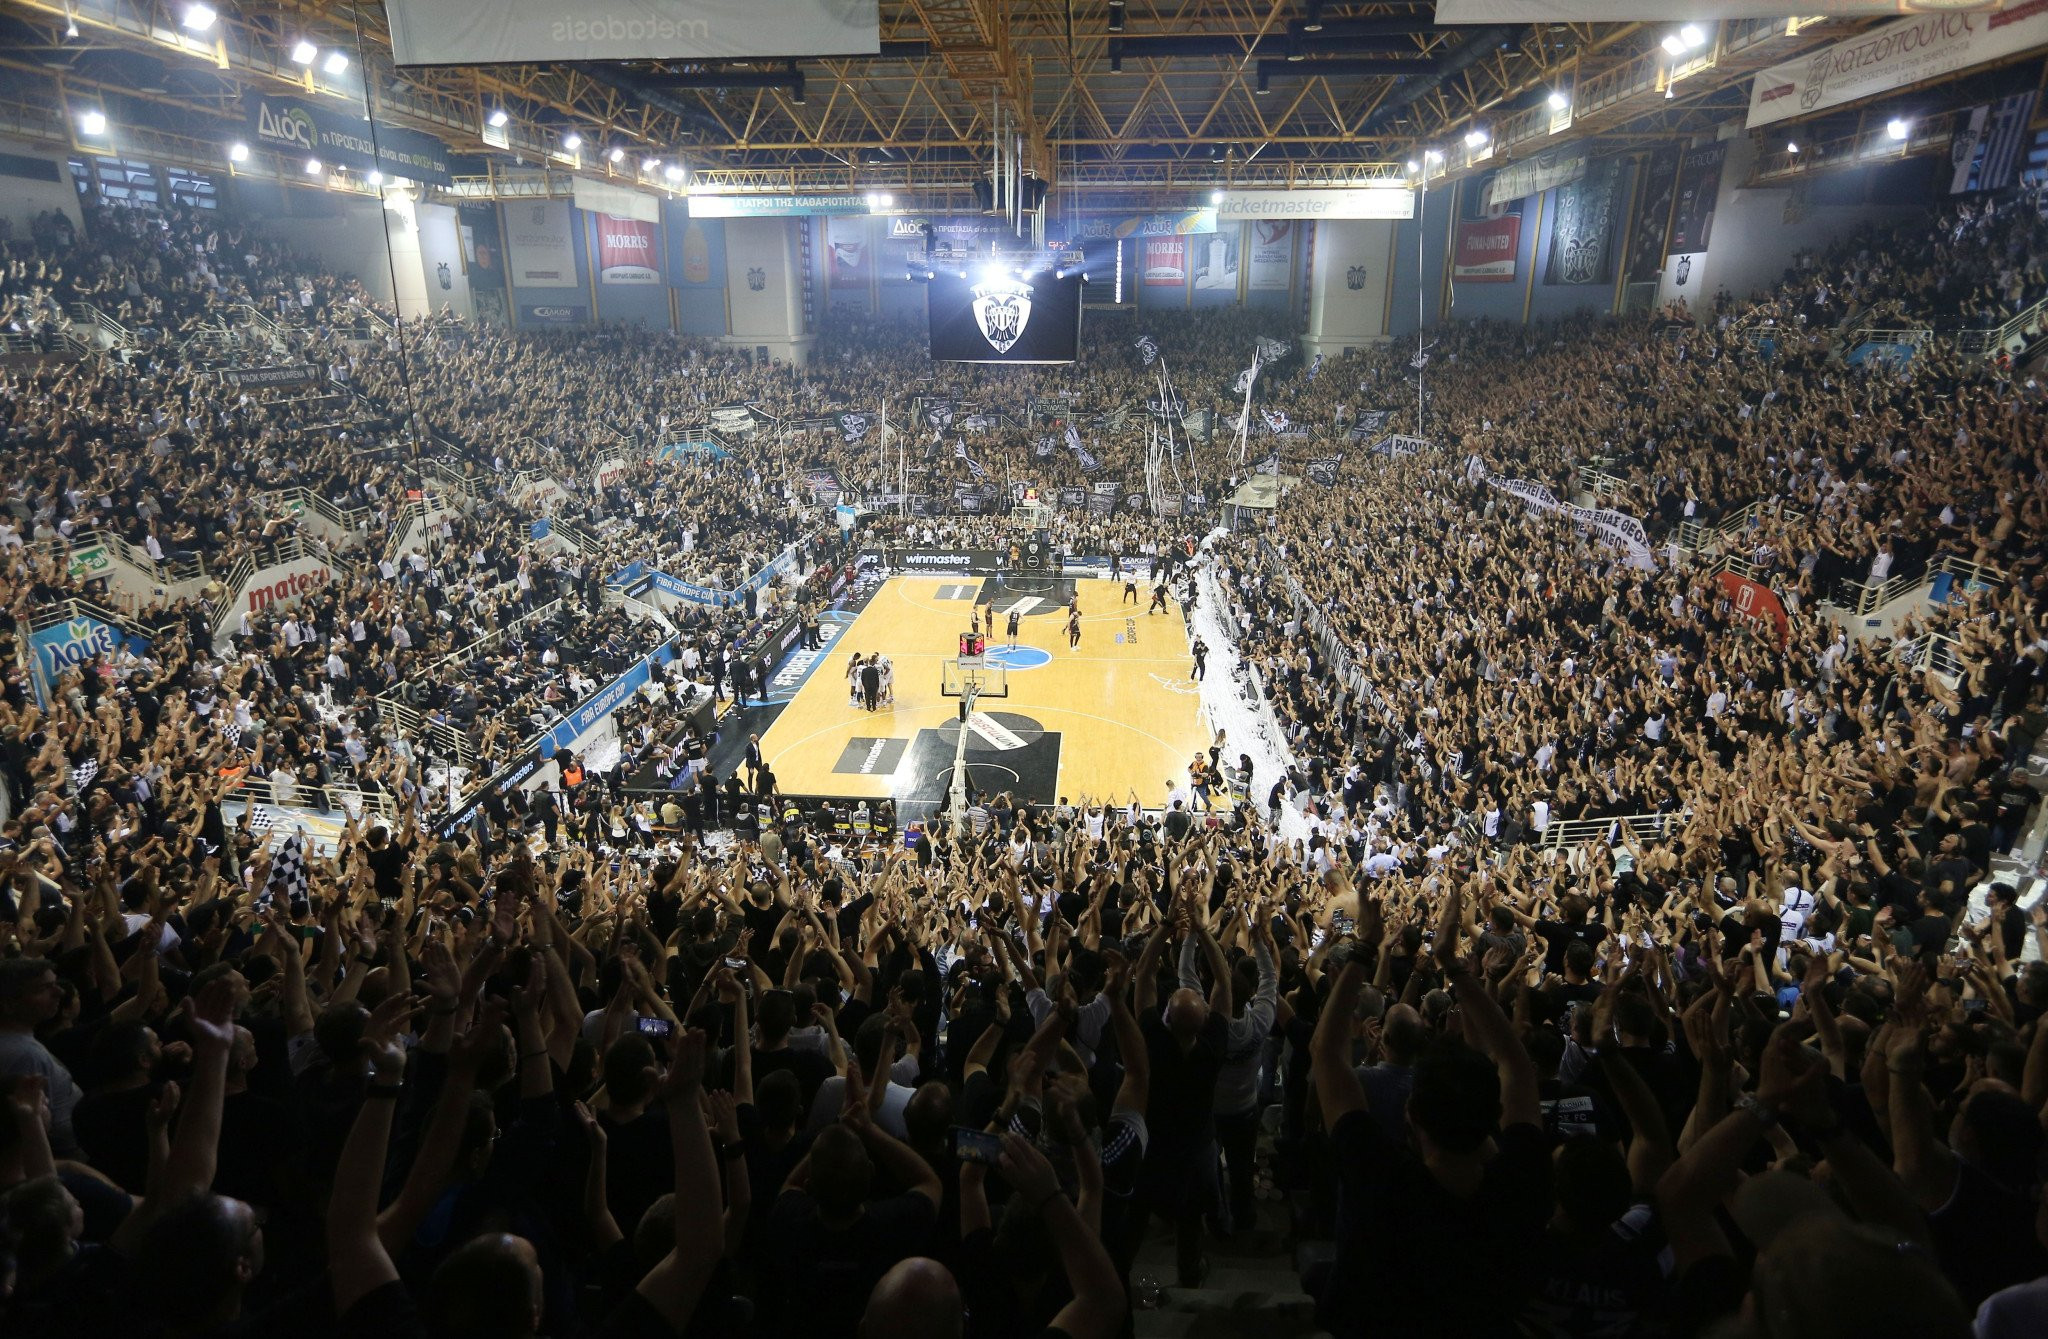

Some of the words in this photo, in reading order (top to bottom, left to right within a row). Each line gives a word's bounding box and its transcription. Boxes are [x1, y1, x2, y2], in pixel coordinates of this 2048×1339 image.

[258, 102, 311, 149] Διός
[331, 131, 378, 156] ΠΡΟΣΤΑΣΙΑ
[775, 197, 794, 207] ΤΗΣ
[795, 196, 869, 207] ΚΑΘΑΡΙΟΤΗΤΑΣ
[1221, 197, 1331, 215] ticketmaster
[938, 225, 973, 234] ΠΡΟΣΤΑΣΙΑ
[606, 234, 648, 249] MORRIS
[1147, 242, 1184, 254] MORRIS
[905, 553, 971, 565] winmasters
[656, 577, 673, 589] FIBA
[673, 582, 701, 598] EUROPE
[581, 707, 596, 727] FIBA
[595, 692, 615, 713] EUROPE
[615, 682, 626, 701] CUP
